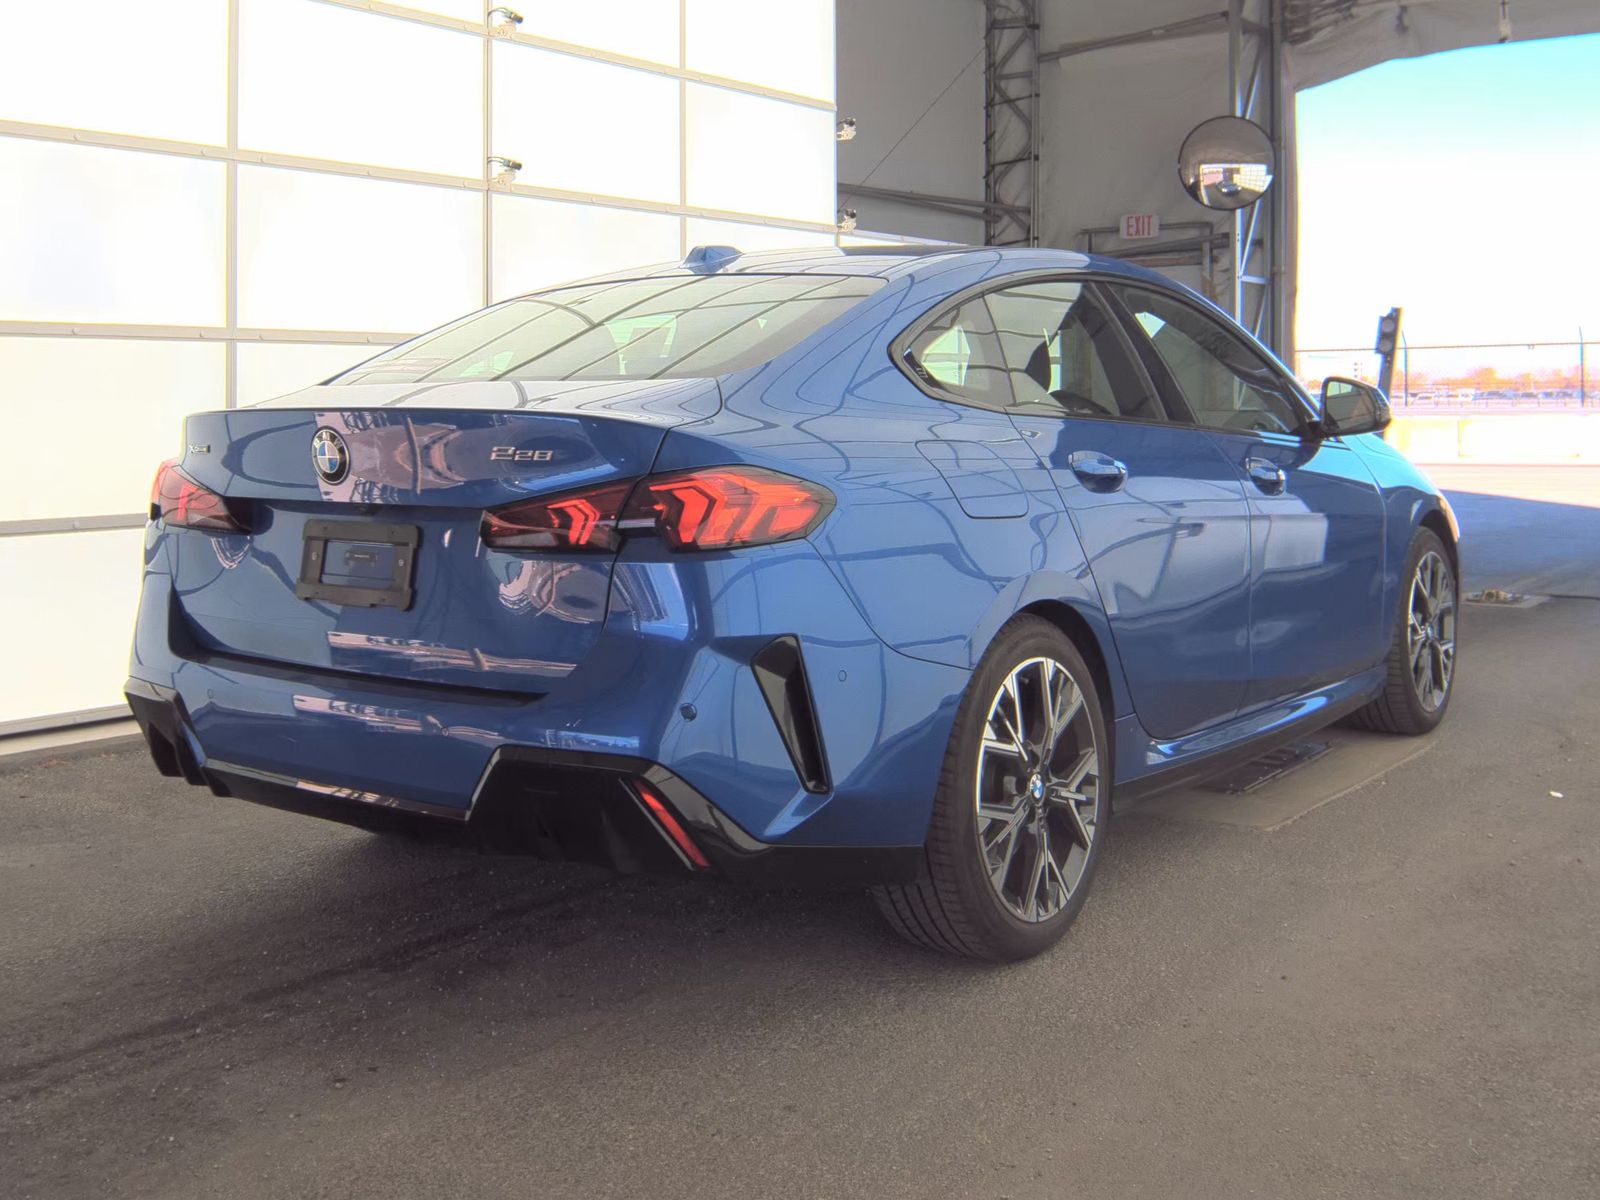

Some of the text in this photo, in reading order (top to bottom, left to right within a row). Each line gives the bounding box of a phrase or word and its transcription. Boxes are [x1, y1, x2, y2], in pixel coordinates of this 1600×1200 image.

[1126, 214, 1153, 236] EXIT
[313, 431, 344, 449] BMW
[490, 446, 554, 461] 228
